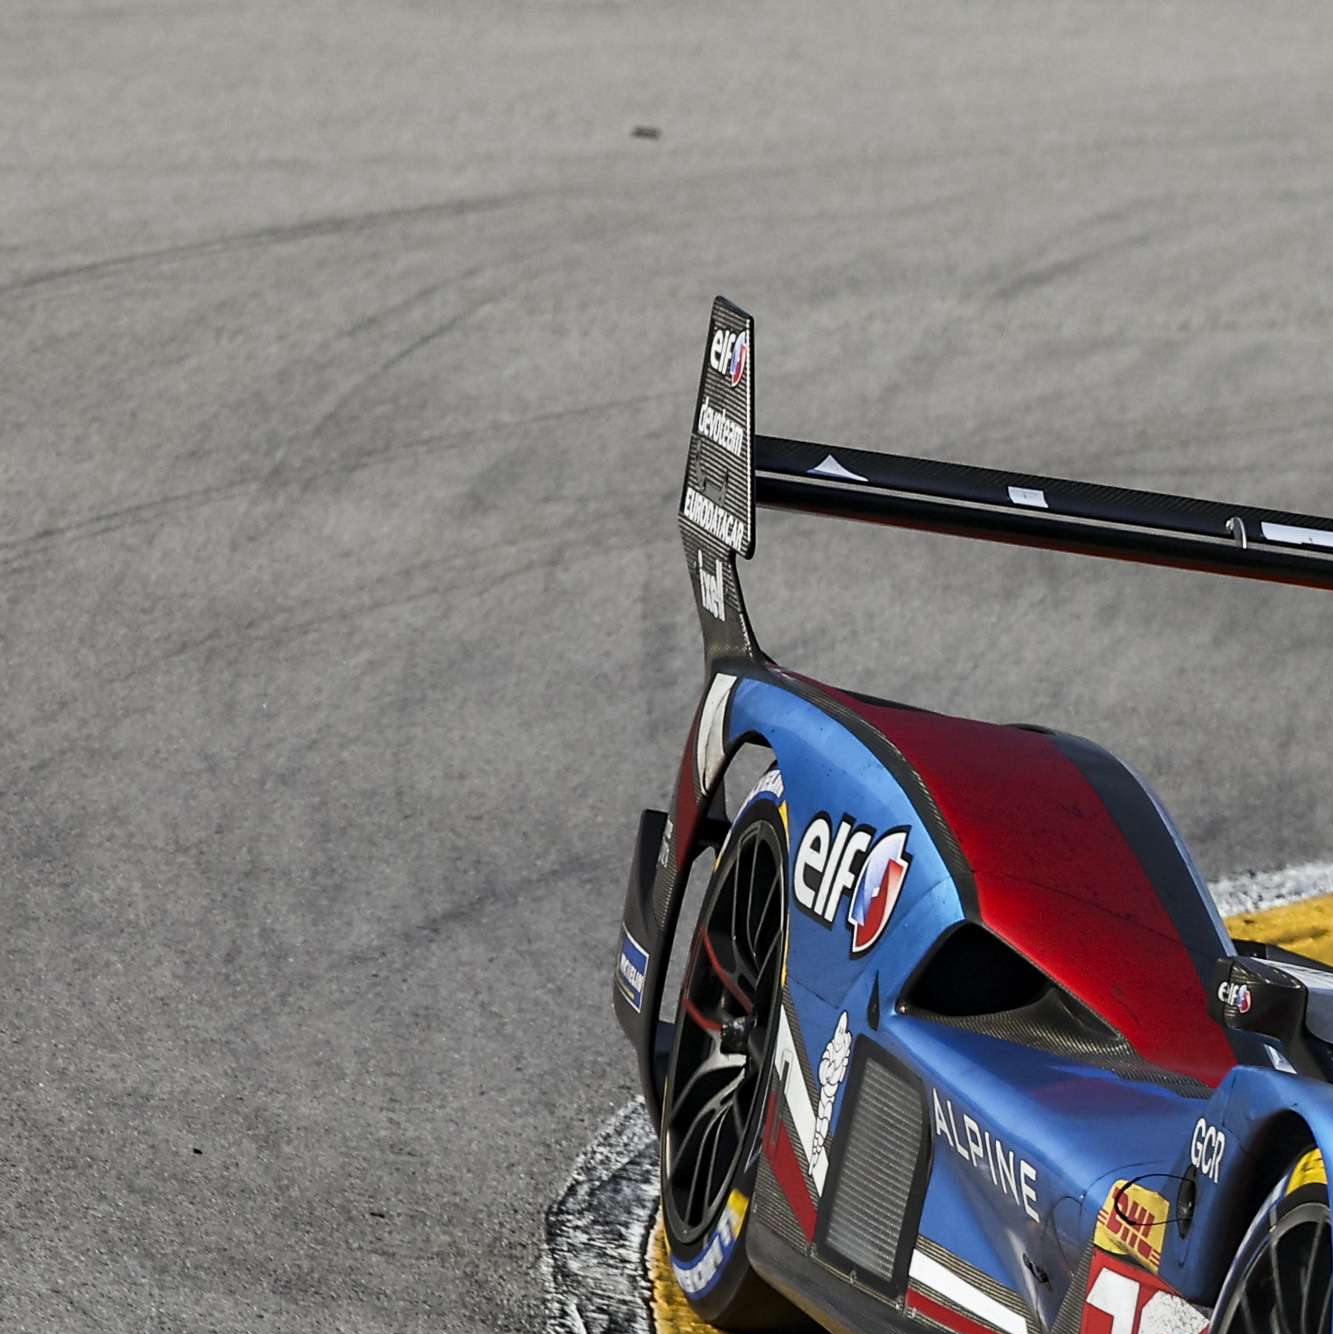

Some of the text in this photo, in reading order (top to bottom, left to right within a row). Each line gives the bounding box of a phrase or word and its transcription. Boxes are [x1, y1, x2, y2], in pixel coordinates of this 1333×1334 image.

[710, 329, 737, 375] elf
[698, 396, 744, 457] devoteam
[684, 487, 745, 552] EURODATACAR
[794, 817, 872, 922] elf
[933, 1088, 1041, 1223] ALPINE
[1190, 1117, 1226, 1184] GCR
[1105, 1186, 1156, 1260] DHL
